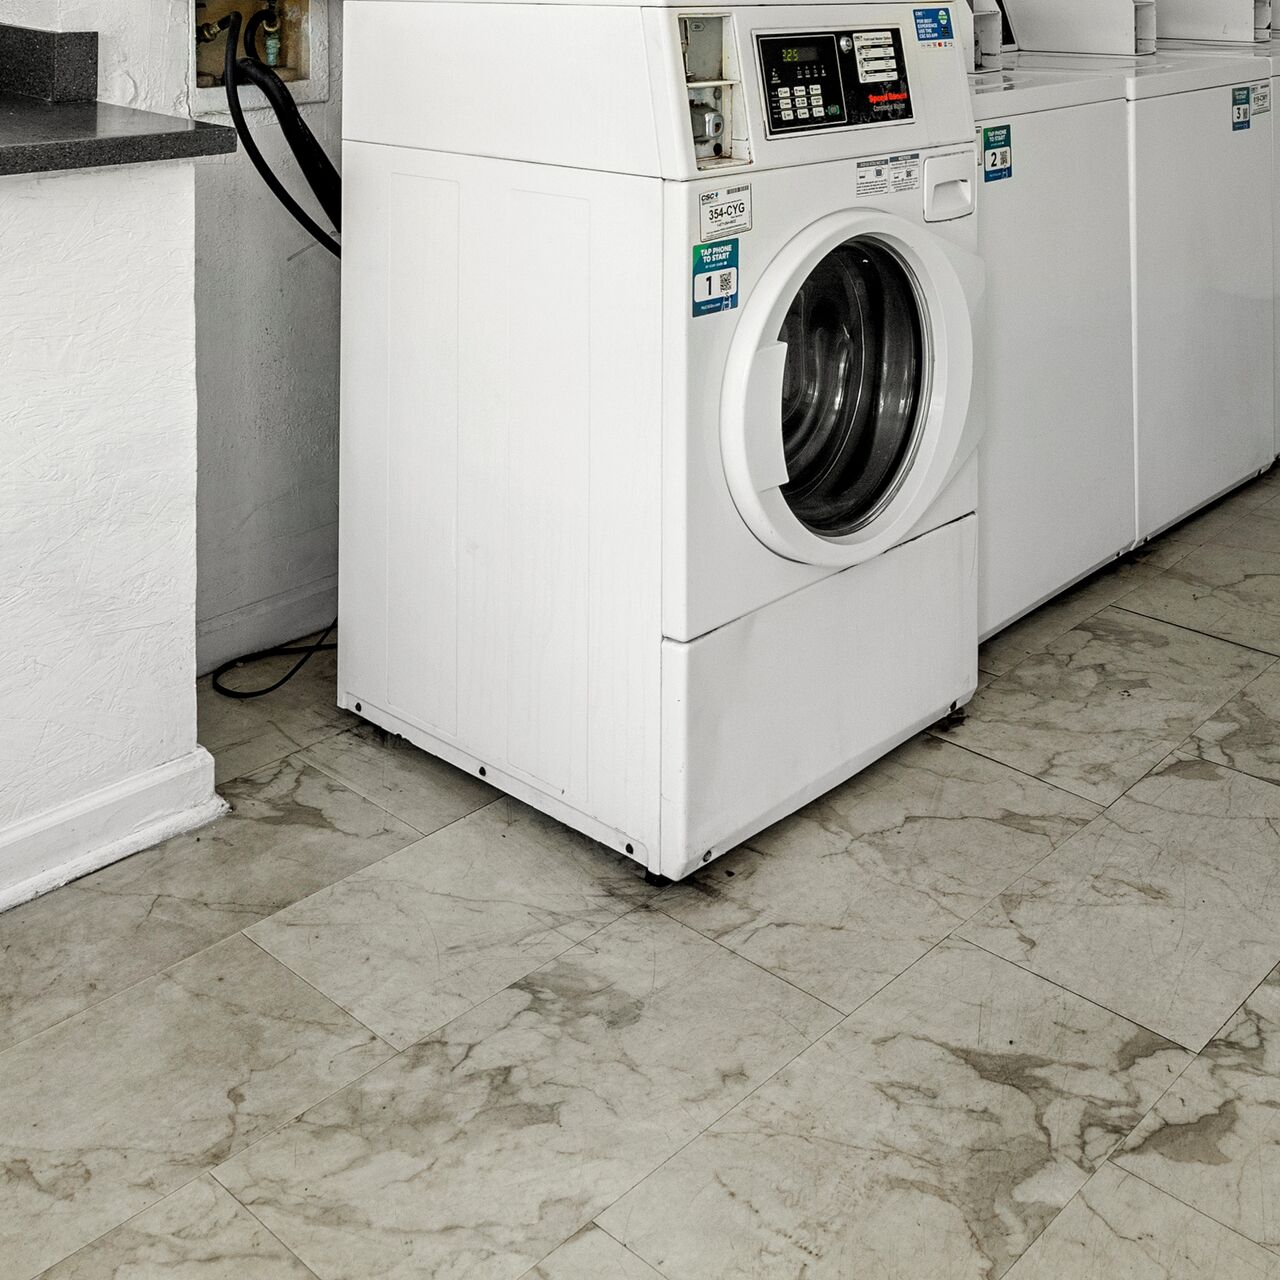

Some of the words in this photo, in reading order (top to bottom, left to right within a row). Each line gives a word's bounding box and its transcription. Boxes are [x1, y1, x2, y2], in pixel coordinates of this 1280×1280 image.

[1236, 107, 1241, 120] 3
[991, 152, 997, 167] 2
[701, 192, 715, 202] CSC
[708, 202, 745, 221] 354-CYG
[701, 248, 712, 256] TAP
[712, 244, 732, 254] PHONE
[703, 254, 712, 263] TO
[711, 251, 730, 261] START
[706, 275, 712, 296] 1
